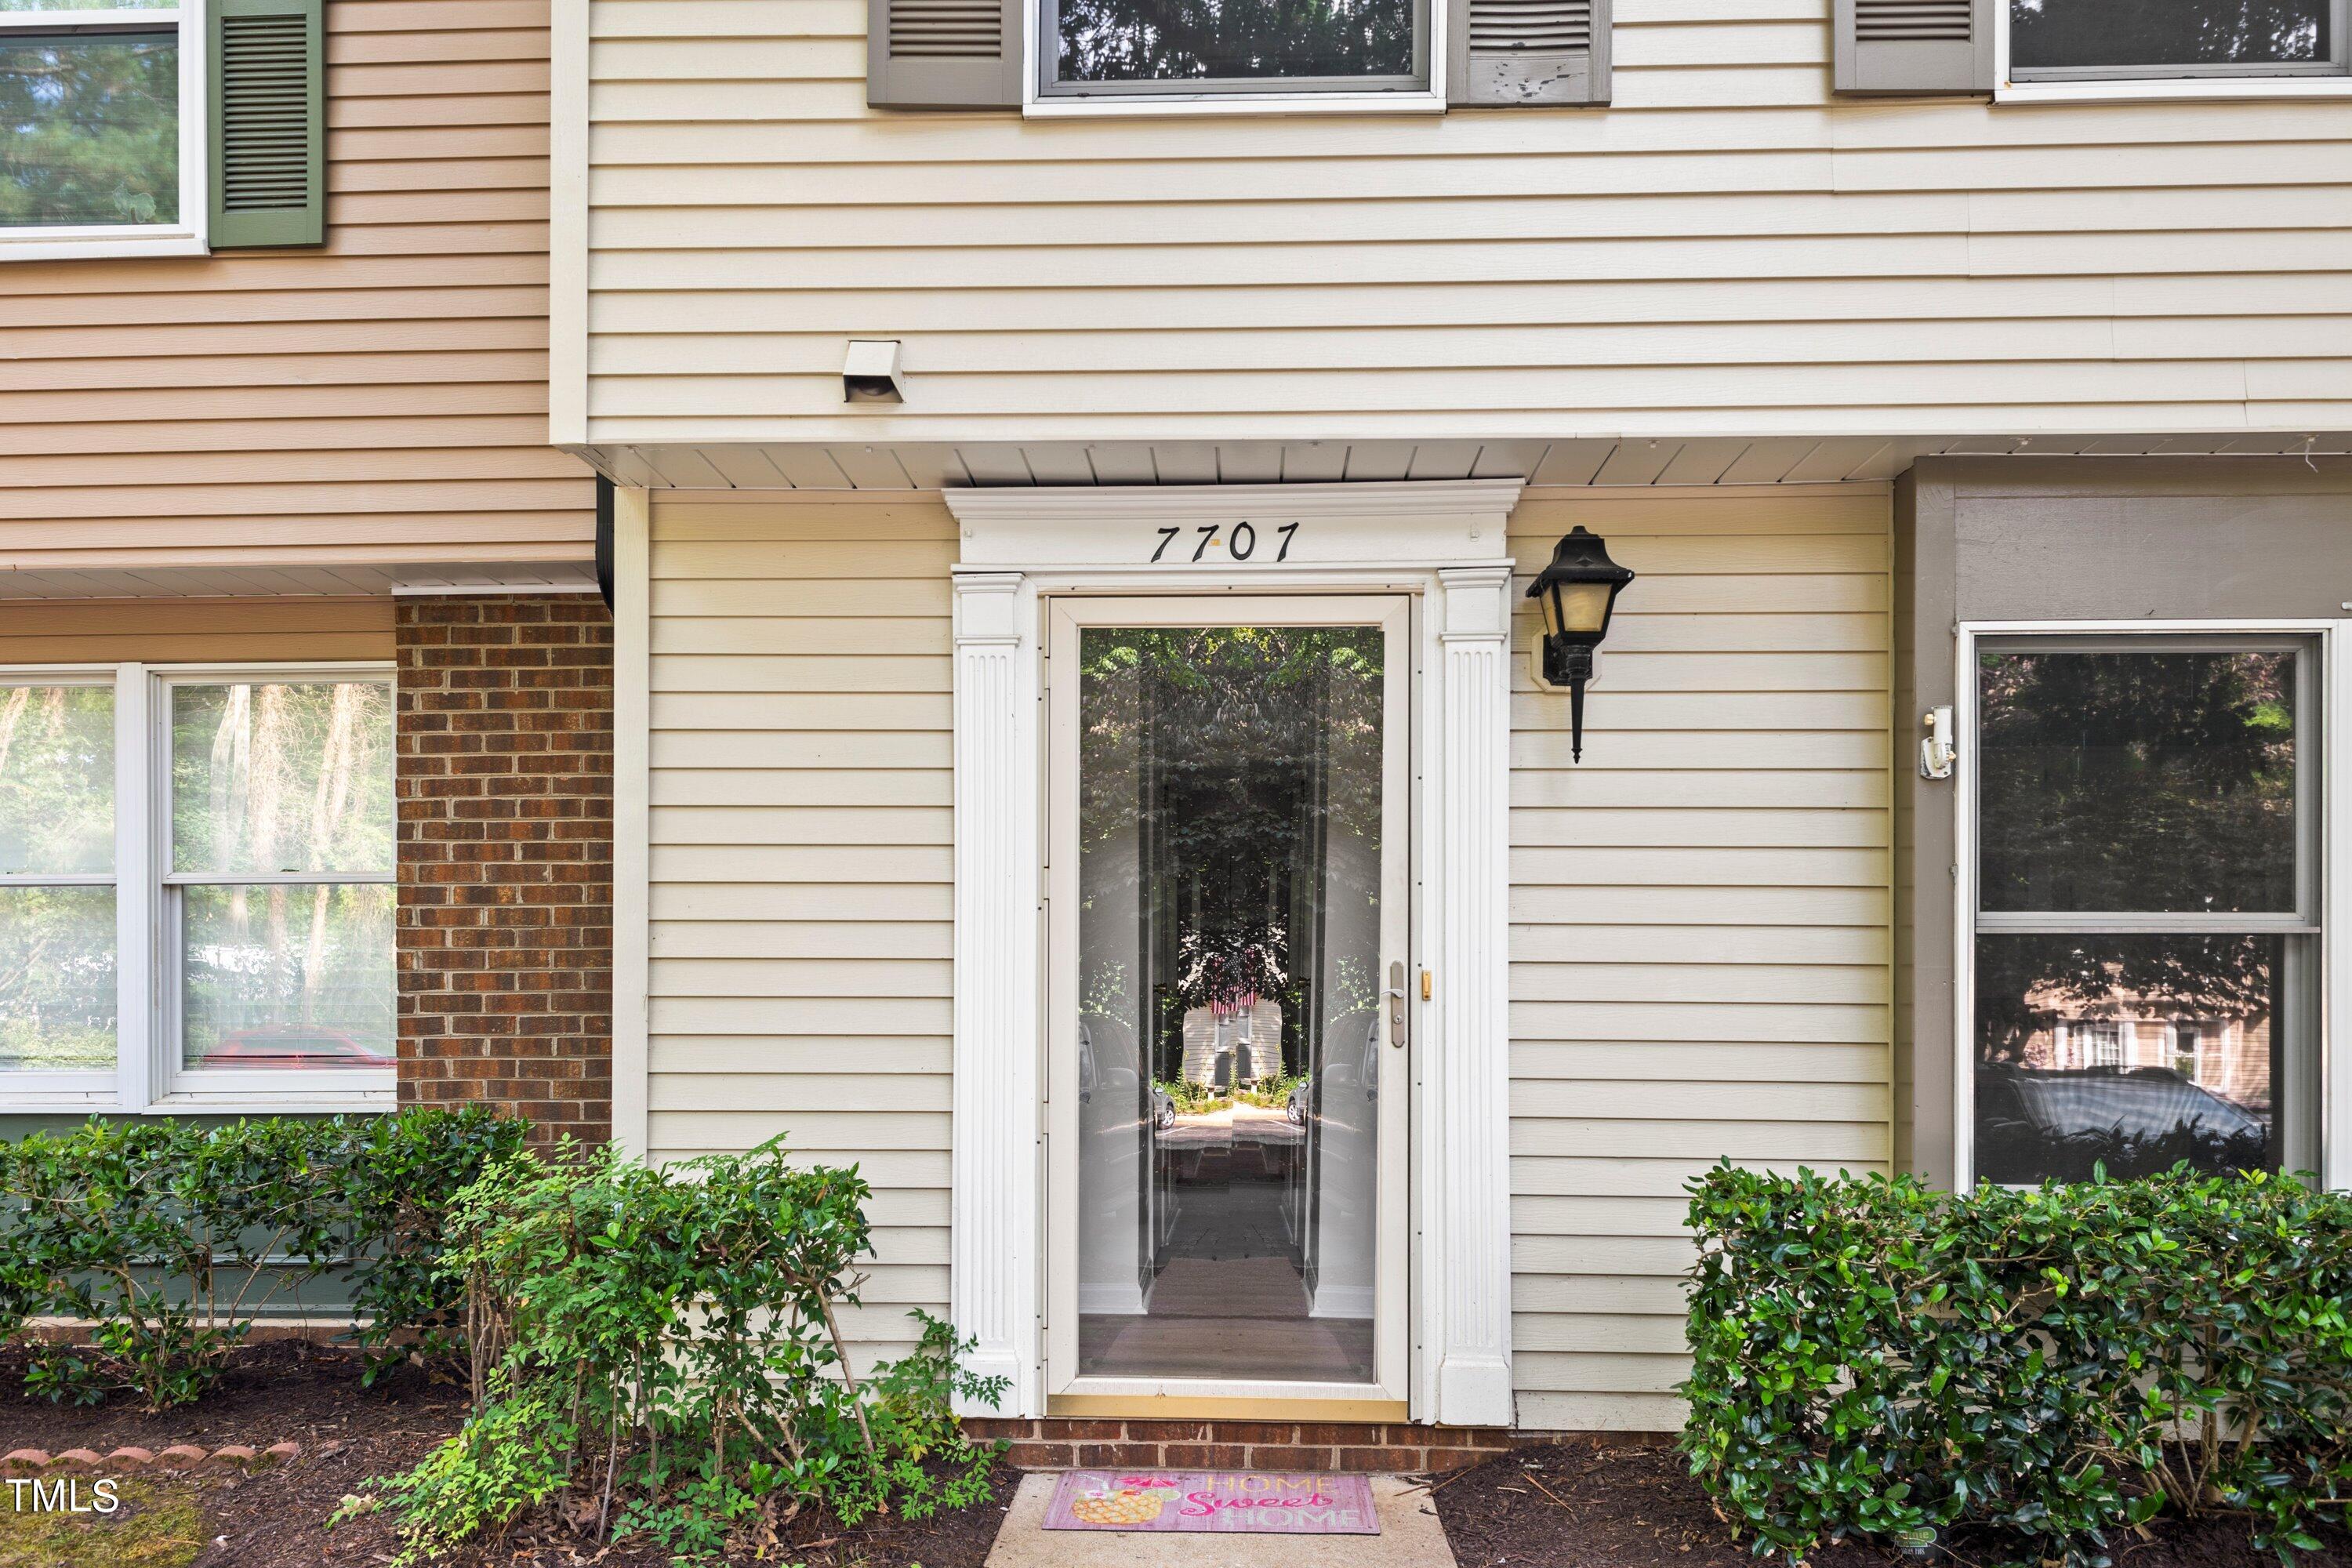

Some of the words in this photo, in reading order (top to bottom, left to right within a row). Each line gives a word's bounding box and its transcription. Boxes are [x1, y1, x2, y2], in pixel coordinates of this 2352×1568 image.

[1150, 521, 1300, 563] 7707
[1206, 1474, 1335, 1493] HOME
[1178, 1491, 1334, 1517] Sweet
[1221, 1508, 1365, 1528] HOME
